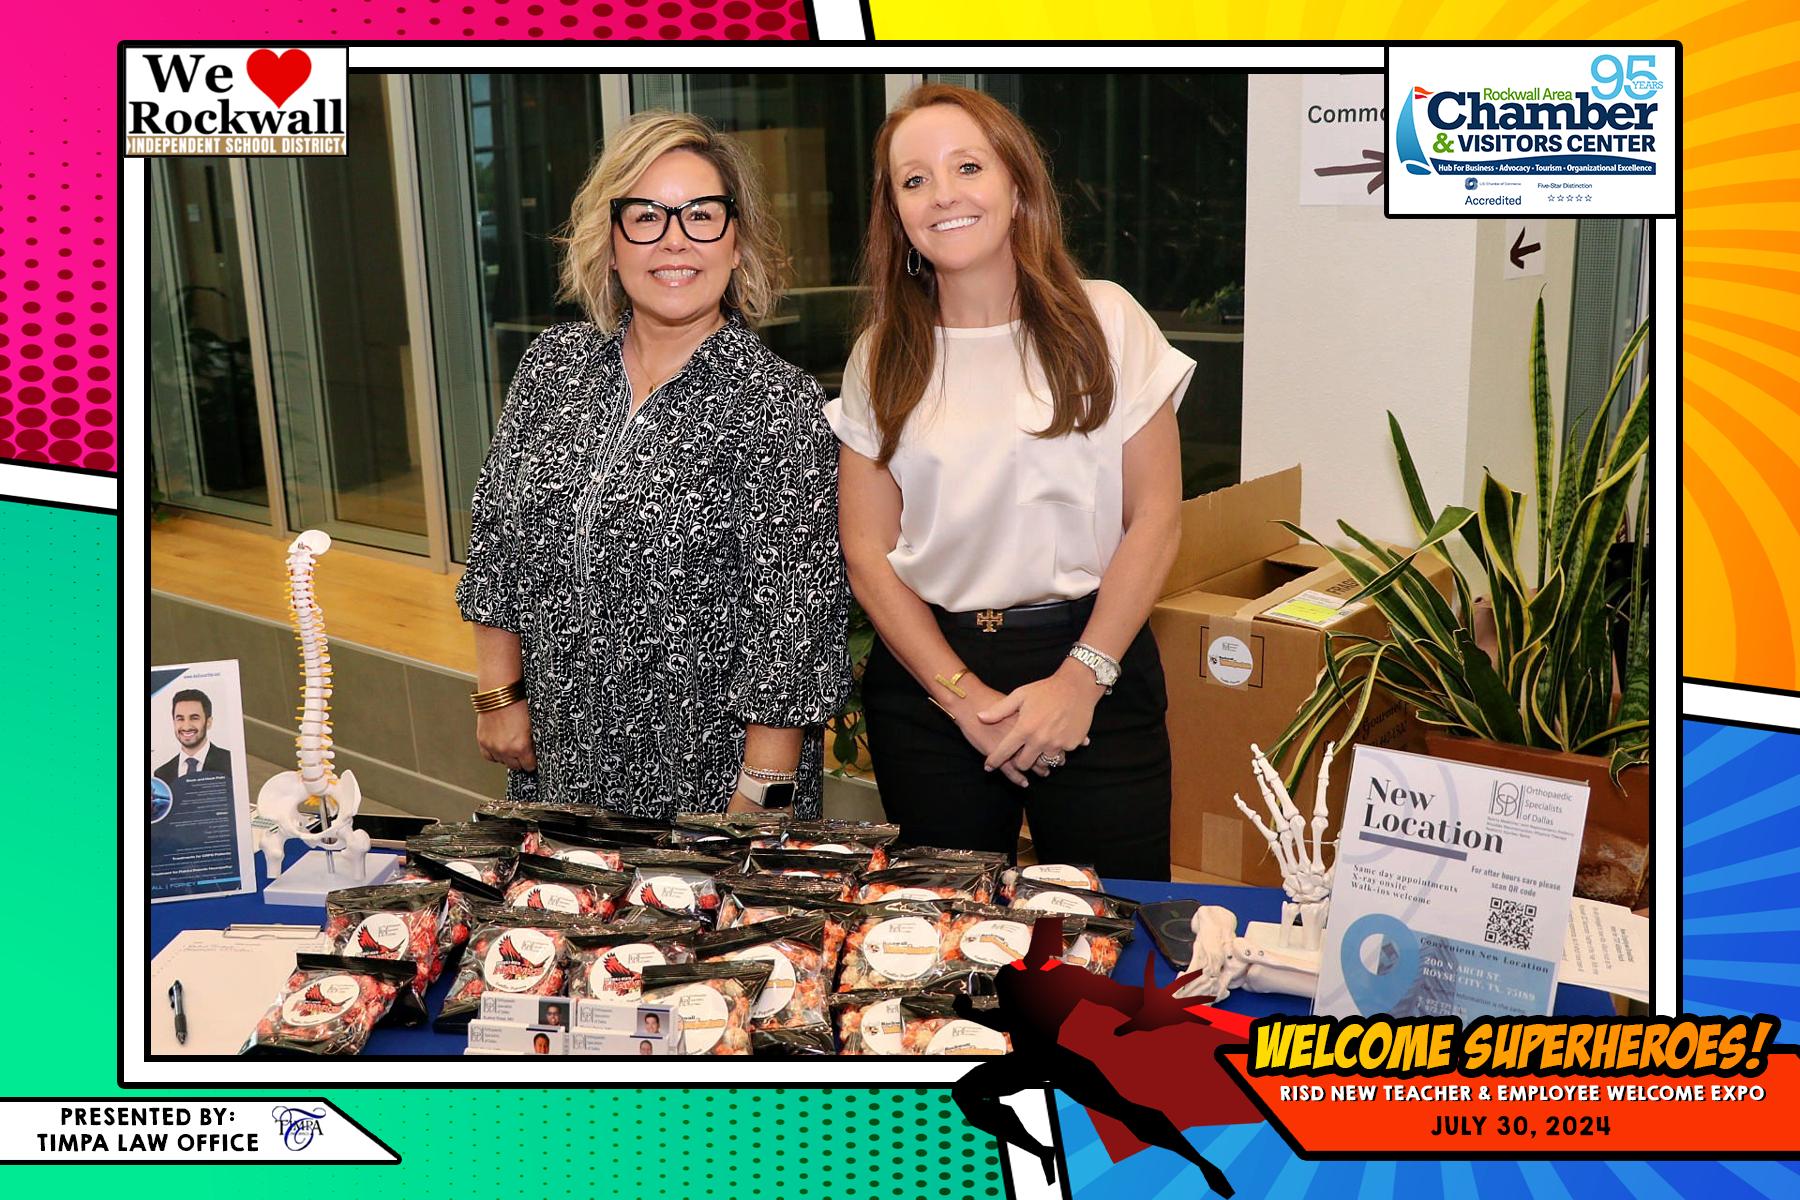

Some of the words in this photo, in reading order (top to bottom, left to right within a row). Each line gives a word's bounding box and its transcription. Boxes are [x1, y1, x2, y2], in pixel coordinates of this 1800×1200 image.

[1367, 776, 1436, 811] New
[1526, 786, 1573, 801] Orthopaedic
[1525, 800, 1562, 813] Specialists
[1362, 803, 1503, 854] Location
[1522, 813, 1531, 821] of
[1532, 815, 1554, 825] Dallas
[1352, 873, 1376, 884] X-ray
[1379, 880, 1407, 891] onsite
[1353, 864, 1376, 875] Same
[1379, 870, 1393, 879] day
[1397, 875, 1458, 893] appointments
[1472, 865, 1482, 874] For
[1483, 869, 1500, 878] after
[1501, 872, 1521, 881] hours
[1522, 877, 1537, 886] care
[1539, 881, 1561, 891] please
[1351, 881, 1390, 896] Walk-ins
[1393, 892, 1431, 905] welcome
[1491, 882, 1506, 890] scan
[1508, 885, 1519, 893] QR
[1520, 888, 1536, 897] code
[1420, 937, 1476, 957] Convenient
[1480, 951, 1498, 961] New
[1503, 956, 1549, 973] Location
[1424, 956, 1443, 967] 200
